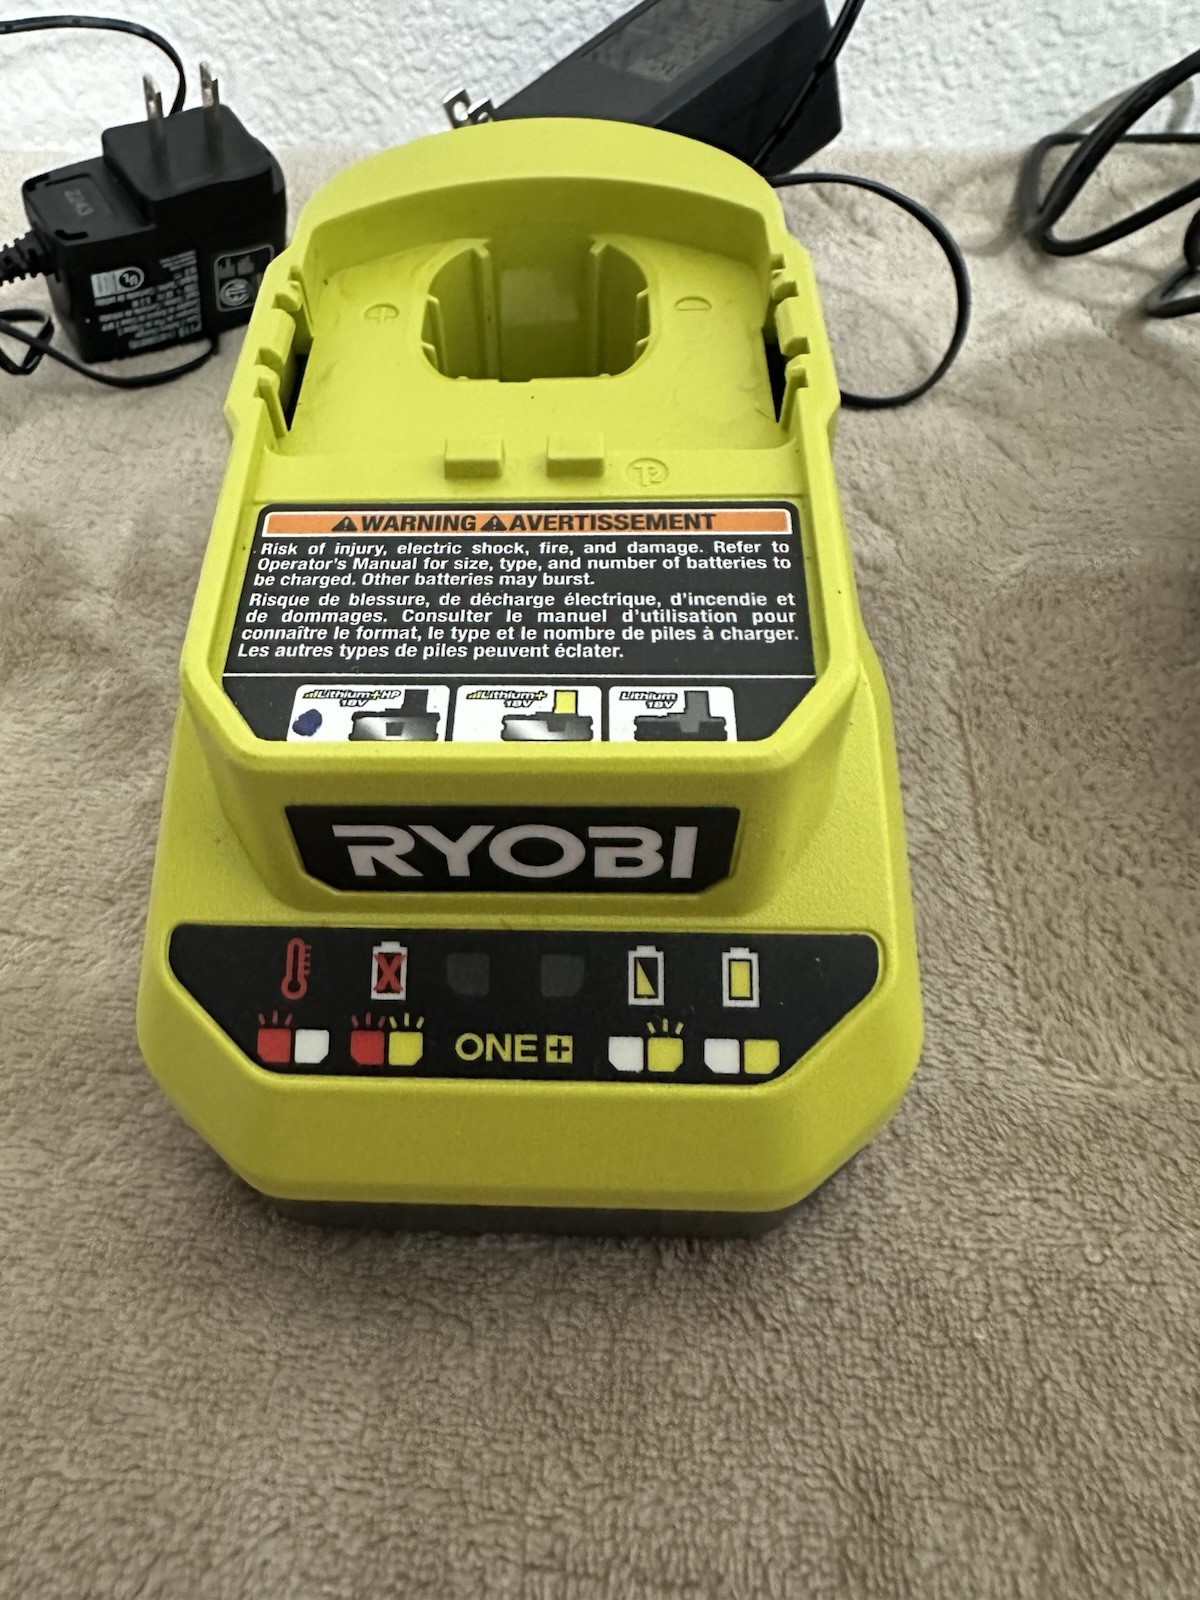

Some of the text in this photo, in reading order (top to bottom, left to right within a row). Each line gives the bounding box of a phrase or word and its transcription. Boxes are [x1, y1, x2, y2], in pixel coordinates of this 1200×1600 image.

[361, 514, 716, 532] WARNING AVERTISSEMENT
[261, 541, 789, 557] Risk of injury, electric shock, fire, and damage. Refer to
[258, 557, 791, 572] Operator's Manual for size, type, and number of batteries to
[254, 573, 595, 588] be charged. Other batteries may burst.
[249, 592, 795, 609] Risque de blessure, de décharge électrique, d'incendie et
[246, 609, 797, 626] de dommages. Consulter le manuel d'utilisation pour
[241, 625, 799, 643] connaître le format, le type et le nombre de piles à charger.
[238, 644, 623, 660] Les autres types de piles peuvent éclater.
[480, 690, 547, 700] Lithium+
[620, 692, 677, 700] Lithium
[504, 700, 534, 708] 18V
[646, 700, 677, 709] 18V
[332, 825, 699, 879] RYOBI
